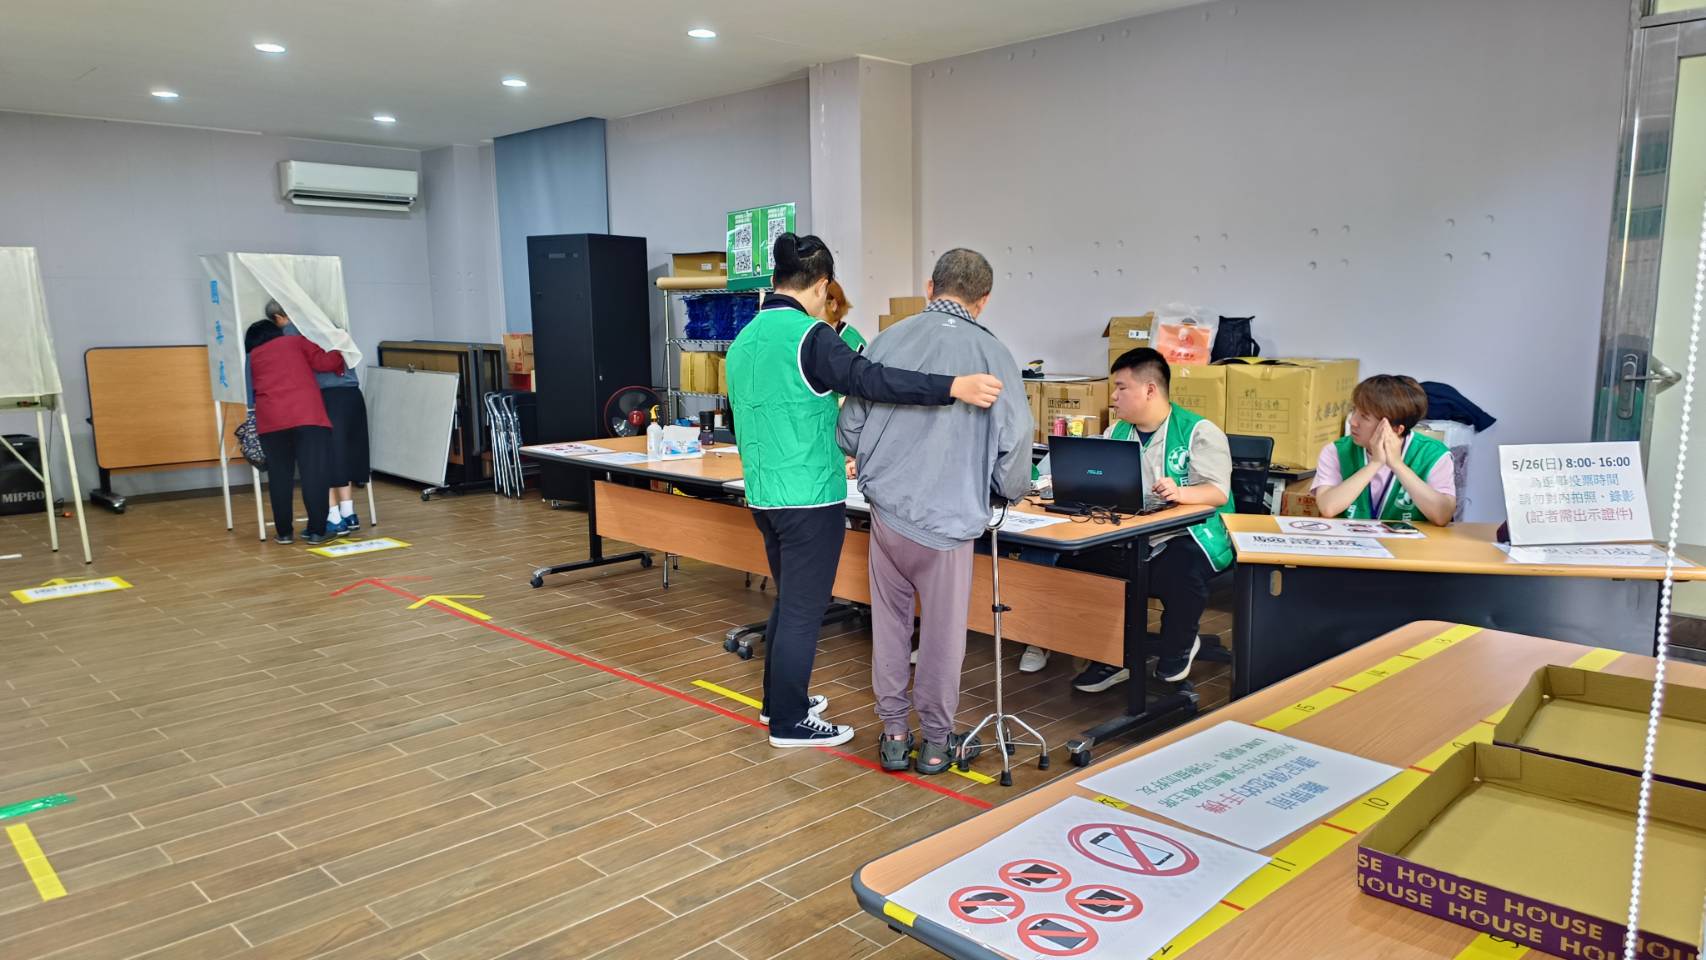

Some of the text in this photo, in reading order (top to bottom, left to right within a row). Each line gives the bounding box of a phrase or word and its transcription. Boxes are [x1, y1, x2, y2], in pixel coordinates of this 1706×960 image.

[1512, 456, 1631, 471] 5/26(日) 8:00- 16:00
[2, 491, 45, 503] MIPRO
[1193, 755, 1323, 815] 請記得您的手機
[1263, 780, 1332, 811] 離開前
[1397, 865, 1488, 905] HOUSE
[1504, 898, 1603, 940] HOUSE
[1448, 902, 1543, 944] HOUSE
